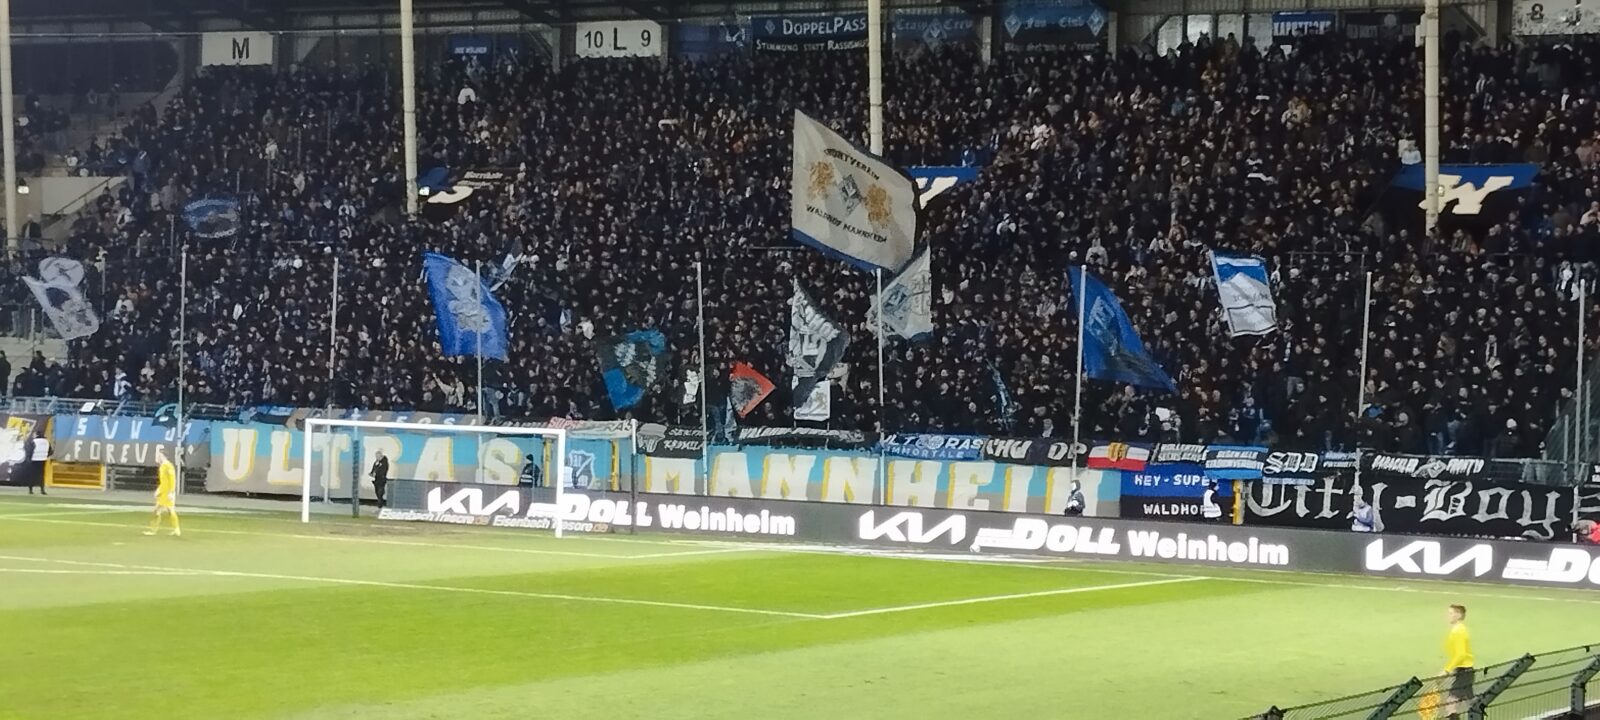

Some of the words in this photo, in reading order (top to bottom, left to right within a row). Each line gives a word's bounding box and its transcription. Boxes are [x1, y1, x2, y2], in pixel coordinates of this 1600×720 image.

[1531, 3, 1544, 21] 8
[232, 37, 250, 60] M
[584, 30, 604, 48] 10
[613, 28, 627, 50] L
[640, 29, 651, 47] 9
[222, 427, 521, 489] ULTRAS
[1134, 473, 1161, 487] HEY
[1173, 474, 1213, 488] SUPE
[427, 486, 520, 516] KIA
[658, 504, 796, 536] Weinheim
[859, 510, 967, 545] KIA
[1127, 529, 1290, 566] Weinheim
[1365, 538, 1494, 577] KIA
